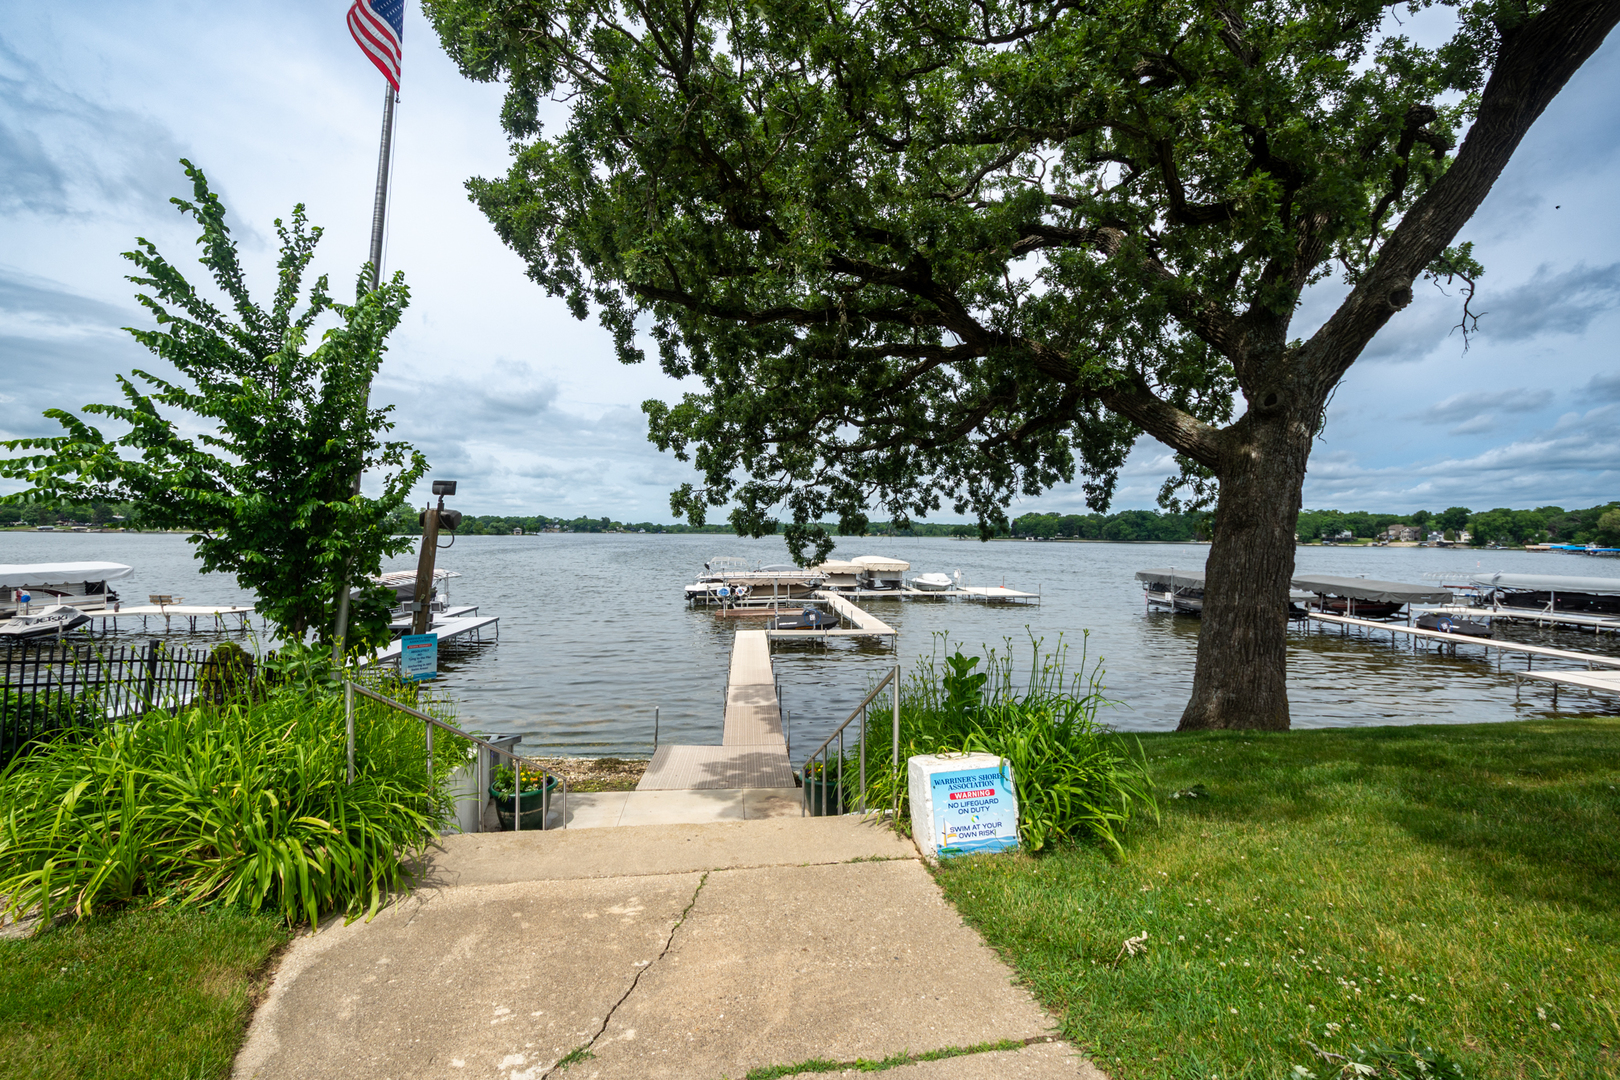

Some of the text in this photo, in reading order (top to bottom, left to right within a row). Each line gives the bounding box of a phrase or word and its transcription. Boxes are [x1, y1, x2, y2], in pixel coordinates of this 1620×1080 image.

[934, 776, 977, 786] WARRINER'S
[948, 780, 995, 791] ASSOCIATION
[954, 789, 990, 799] WARNING
[960, 798, 999, 807] LIFEGUARD
